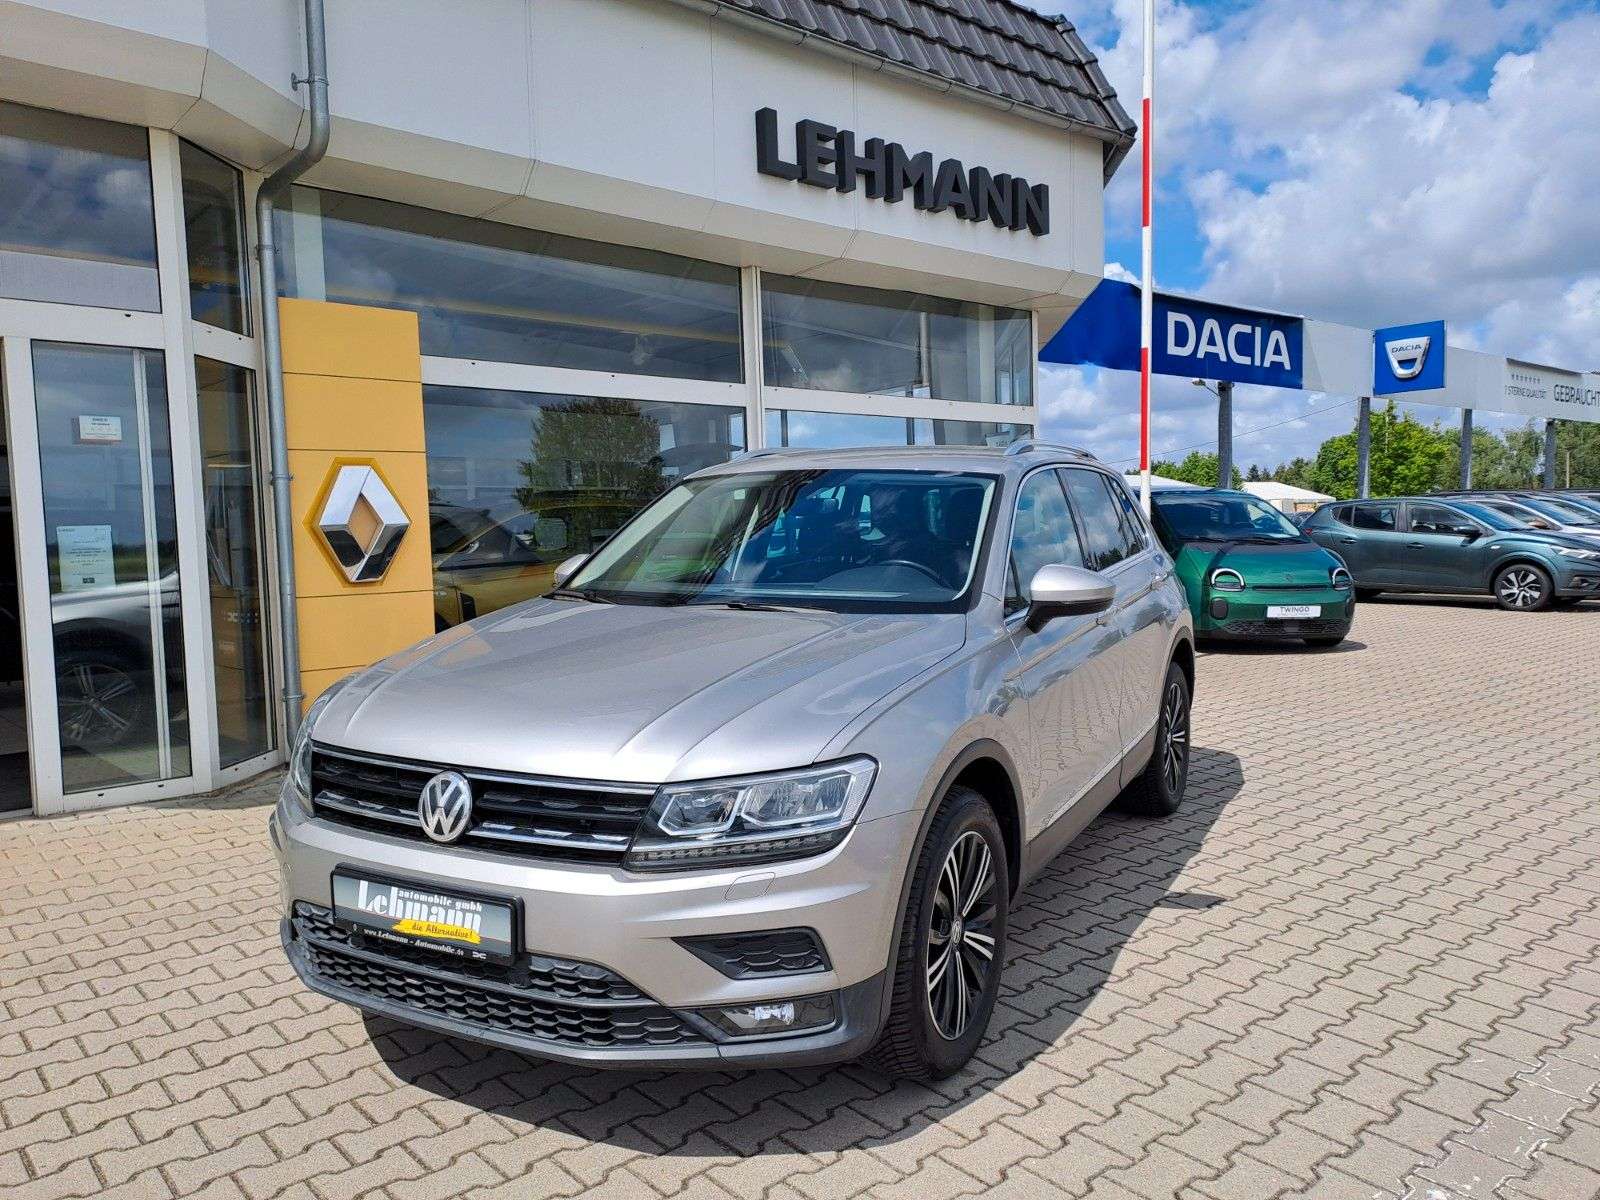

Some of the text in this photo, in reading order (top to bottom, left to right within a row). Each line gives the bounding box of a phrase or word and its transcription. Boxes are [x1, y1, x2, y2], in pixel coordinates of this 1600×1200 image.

[755, 107, 1049, 236] LEHMANN
[1167, 311, 1291, 371] DACIA
[1391, 344, 1422, 353] DACIA
[357, 880, 482, 935] Lehmann
[398, 889, 483, 912] automobile gmbh
